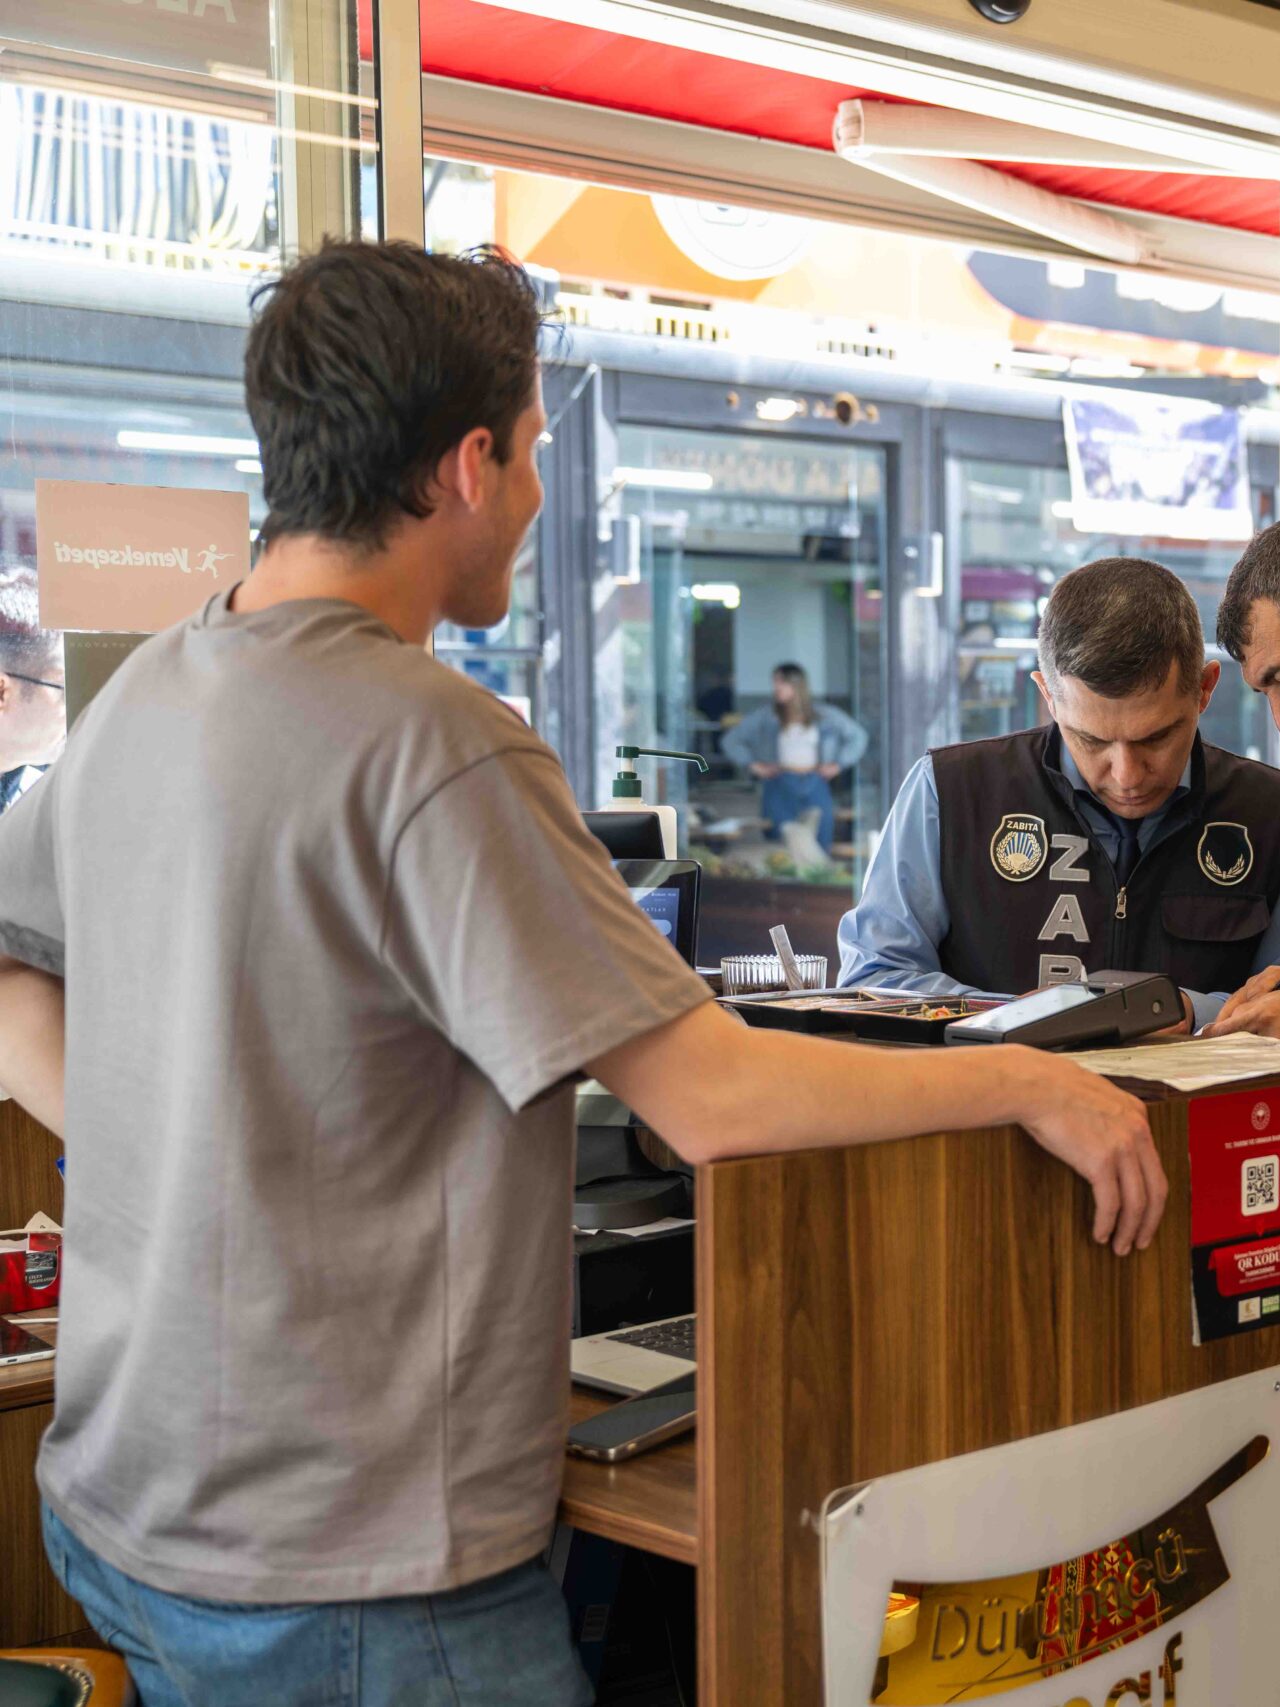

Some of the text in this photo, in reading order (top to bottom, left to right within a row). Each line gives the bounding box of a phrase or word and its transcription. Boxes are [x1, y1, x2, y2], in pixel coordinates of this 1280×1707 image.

[1006, 820, 1039, 832] ZABITA
[1237, 1256, 1253, 1272] QR
[931, 1527, 1188, 1662] Dürümcü
